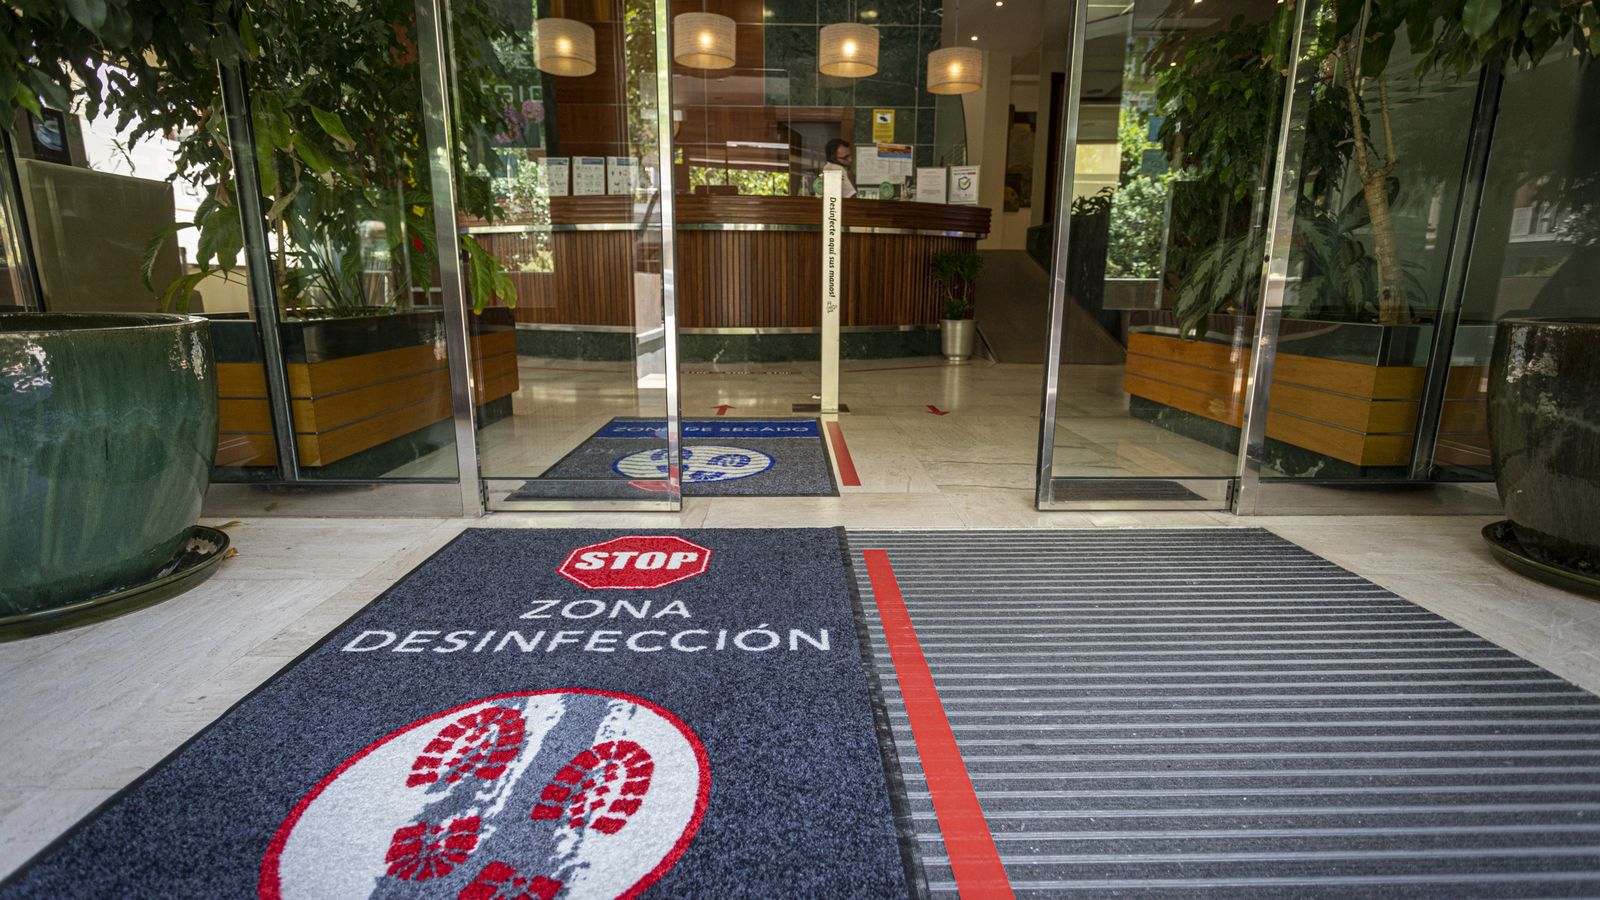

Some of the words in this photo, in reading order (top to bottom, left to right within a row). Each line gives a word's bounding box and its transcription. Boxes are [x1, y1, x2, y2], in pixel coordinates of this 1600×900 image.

[829, 197, 837, 236] Desinfecte
[828, 237, 836, 255] aquí
[575, 551, 700, 571] STOP
[519, 599, 692, 620] ZONA
[341, 623, 831, 654] DESINFECCIÓN
